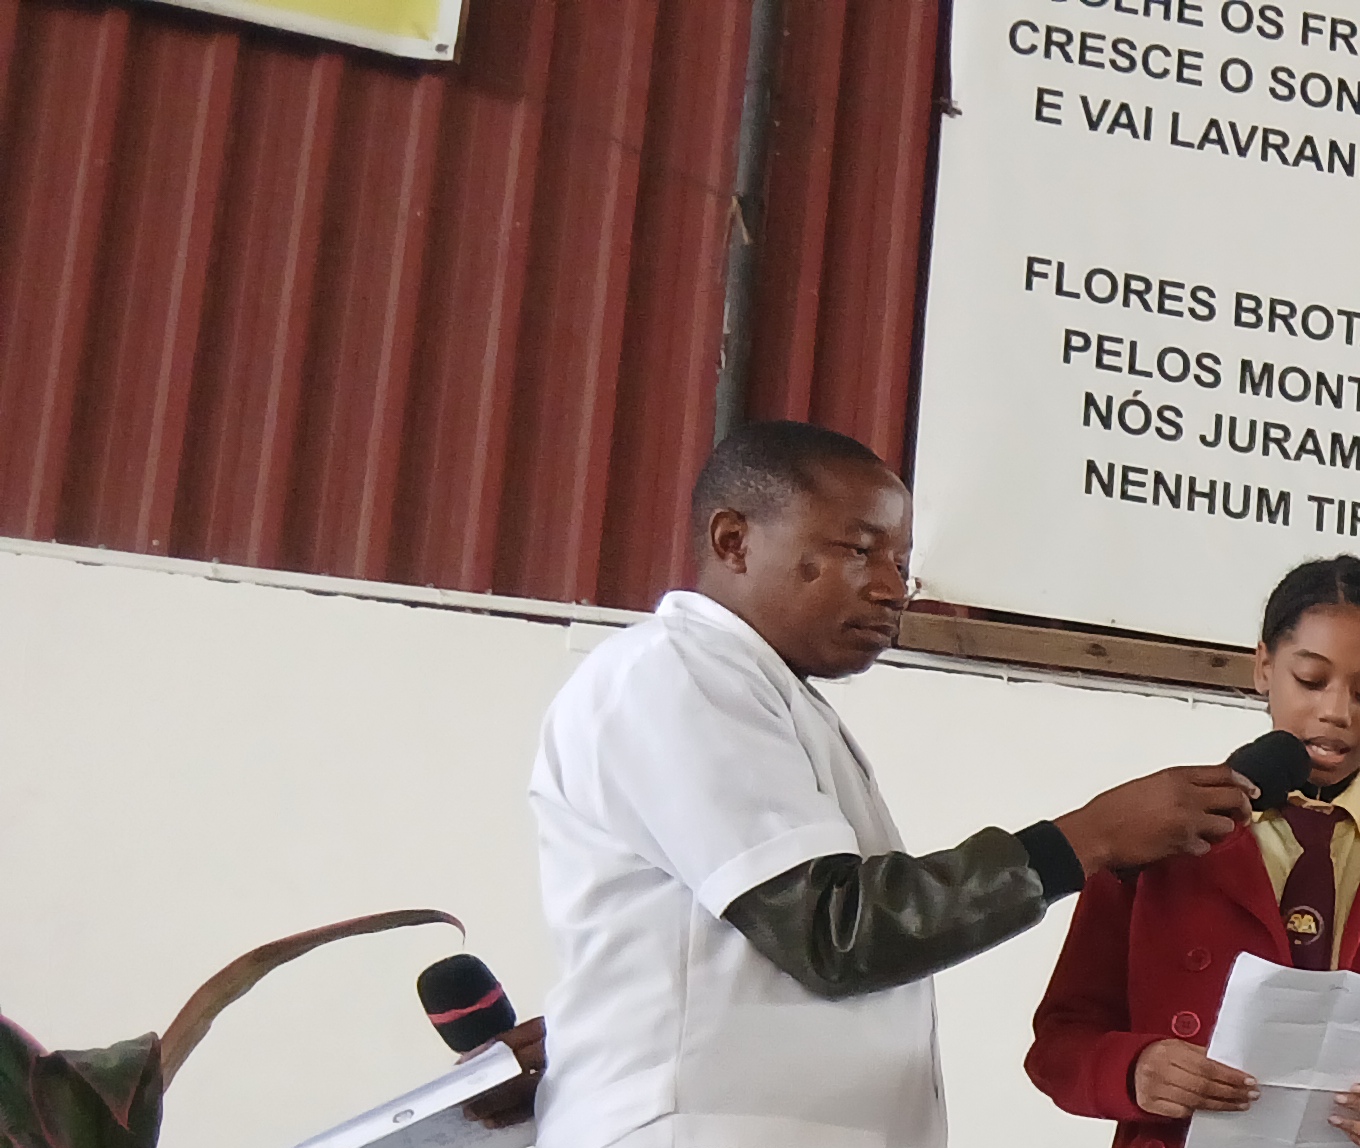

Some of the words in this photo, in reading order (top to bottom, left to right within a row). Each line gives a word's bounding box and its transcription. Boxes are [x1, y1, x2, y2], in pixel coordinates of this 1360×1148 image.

[1220, 0, 1285, 41] OS
[1008, 19, 1205, 87] CRESCE
[1219, 57, 1254, 94] O
[1034, 86, 1064, 126] E
[1078, 94, 1154, 142] VAI
[1024, 255, 1217, 323] FLORES
[1062, 328, 1222, 389] PELOS
[1082, 389, 1184, 442] NÓS
[1084, 458, 1291, 527] NENHUM
